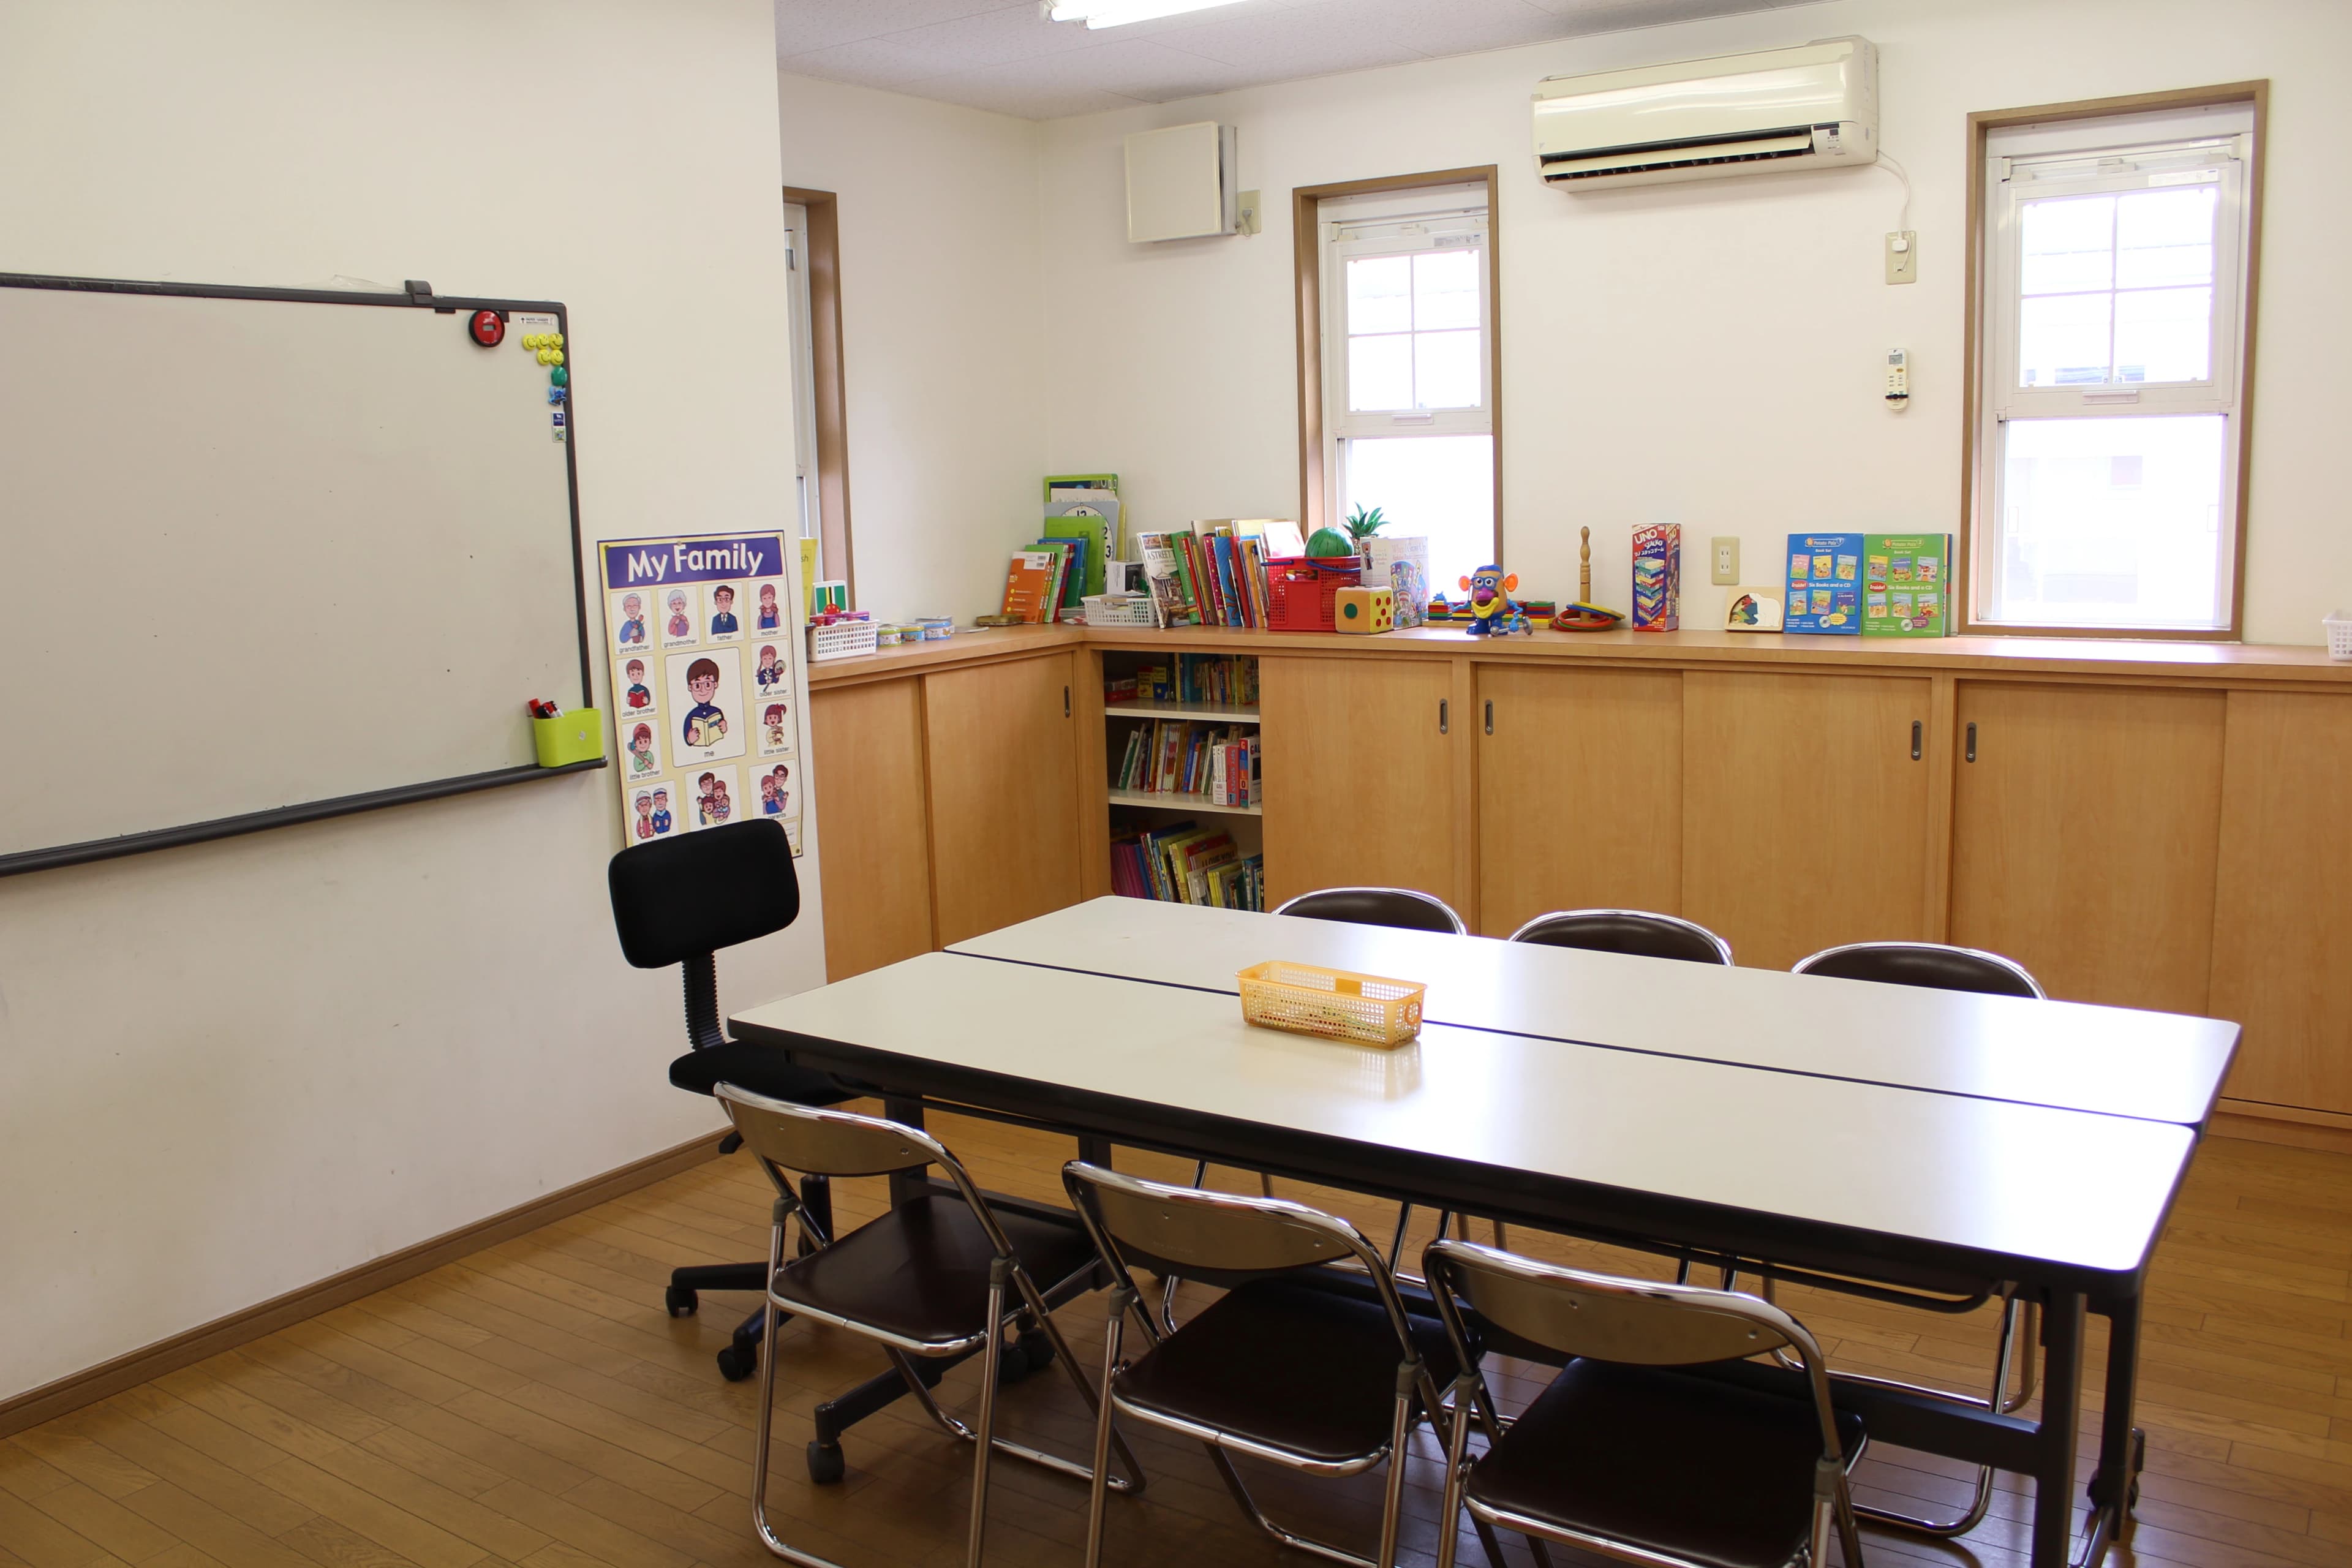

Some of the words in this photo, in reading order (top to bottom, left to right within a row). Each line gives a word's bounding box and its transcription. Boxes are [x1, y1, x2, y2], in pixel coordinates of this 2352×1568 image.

[1634, 529, 1657, 544] UNO
[1667, 529, 1676, 544] UNO
[1106, 545, 1111, 558] 3
[1147, 551, 1152, 560] A
[1151, 550, 1171, 560] STREET
[628, 550, 668, 582] My
[674, 543, 764, 576] Family
[663, 638, 697, 648] grandmother
[619, 644, 650, 654] grandfather
[636, 707, 656, 715] brother
[641, 769, 660, 778] brother
